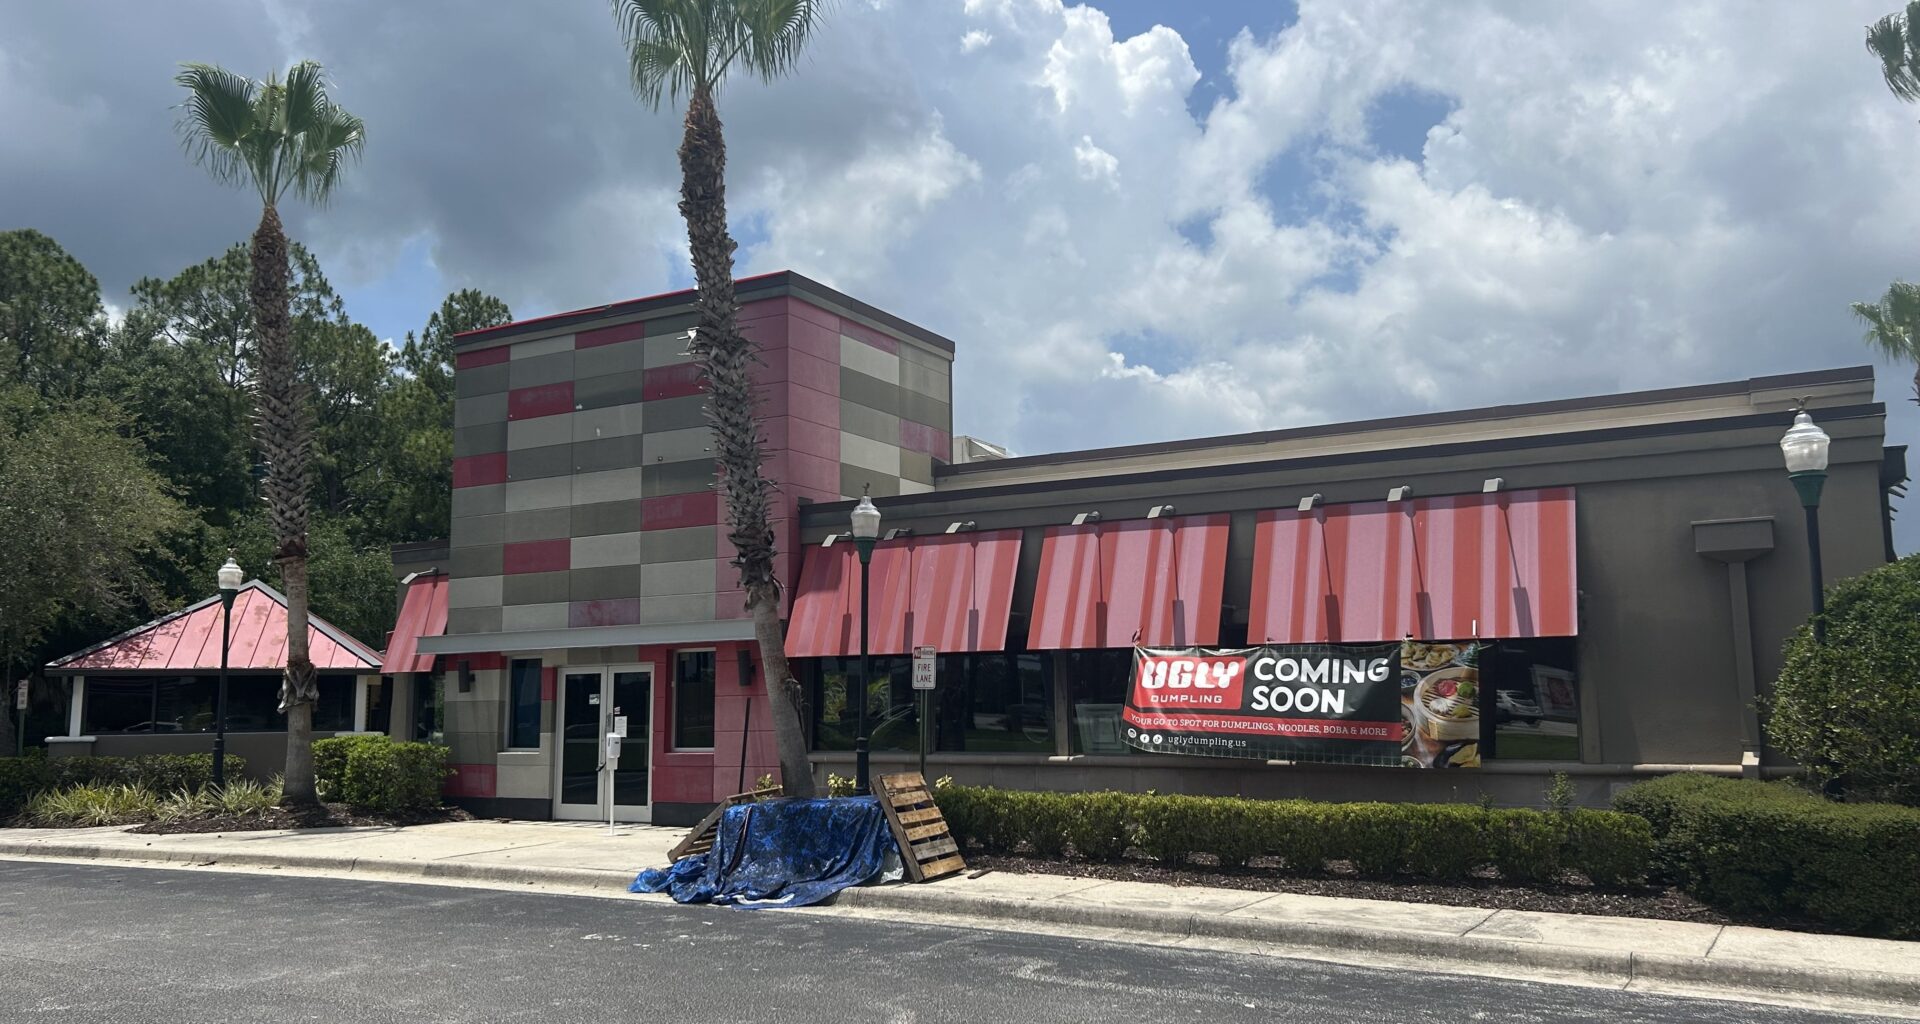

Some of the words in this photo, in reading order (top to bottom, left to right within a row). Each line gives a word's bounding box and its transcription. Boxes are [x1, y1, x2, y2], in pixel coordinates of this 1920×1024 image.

[917, 664, 931, 672] FIRE
[1141, 660, 1239, 689] UGLY
[1254, 657, 1390, 684] COMING
[916, 674, 932, 682] LANE
[1150, 694, 1223, 704] DUMPLING
[1251, 685, 1345, 713] SOON
[1131, 713, 1152, 726] YOUR
[1153, 718, 1166, 726] GO
[1167, 718, 1179, 727] TO
[1180, 719, 1202, 728] SPOT
[1203, 720, 1220, 729] FOR
[1221, 720, 1276, 732] DUMPLINGS,
[1277, 723, 1322, 734] NOODLES,
[1323, 725, 1349, 735] BOBA
[1350, 726, 1358, 735] &
[1359, 727, 1388, 736] MORE
[1168, 735, 1247, 748] uglydumpling.us
